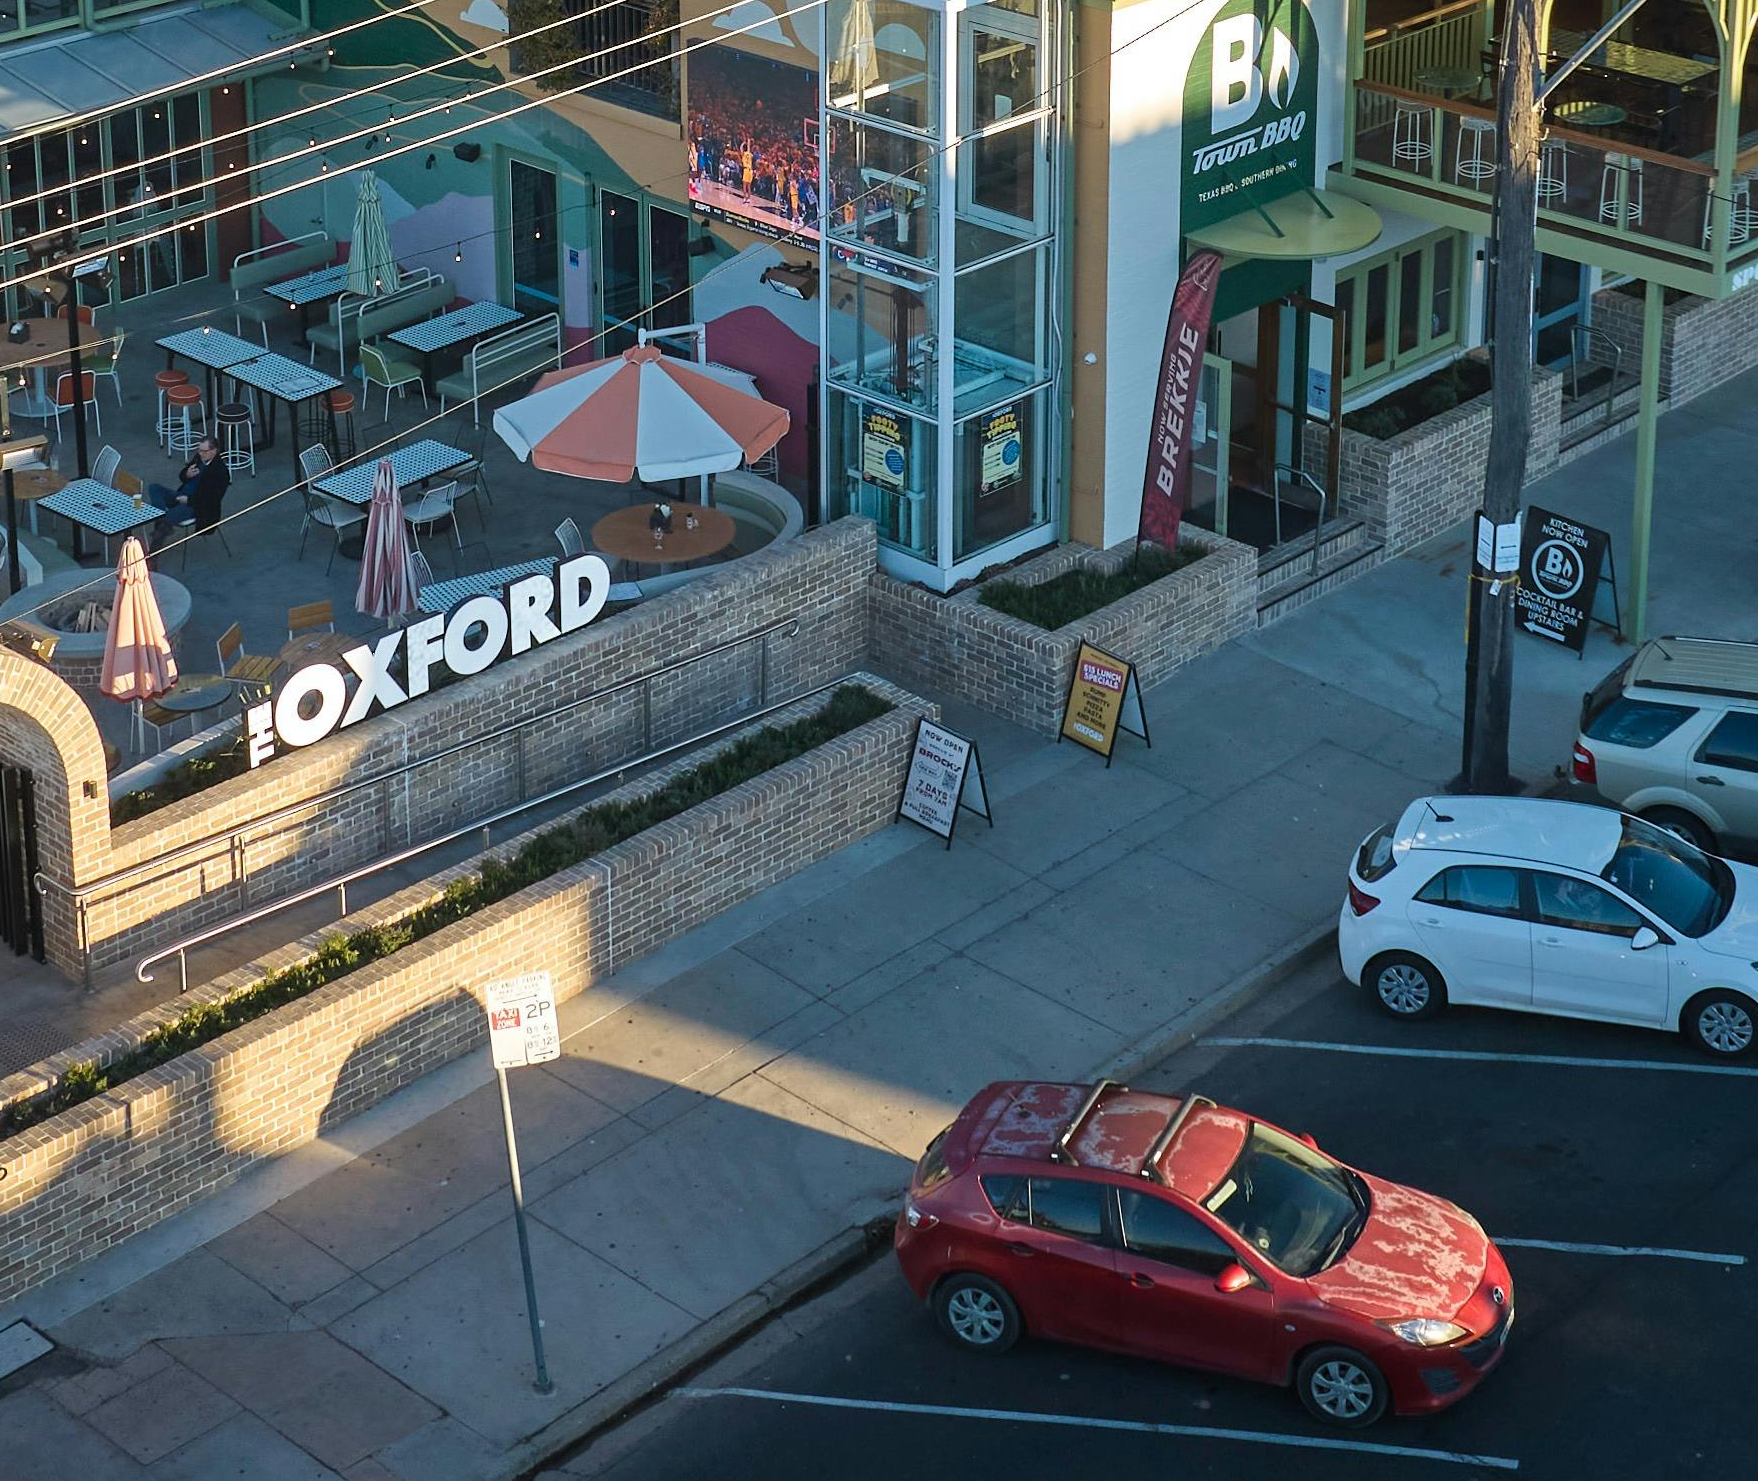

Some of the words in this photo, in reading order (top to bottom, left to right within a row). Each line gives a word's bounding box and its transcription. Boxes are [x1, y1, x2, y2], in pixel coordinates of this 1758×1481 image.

[1260, 110, 1307, 150] BBQ
[1199, 188, 1220, 203] TEXAS
[1241, 167, 1274, 187] SOUTHERN
[1157, 410, 1168, 444] NOW
[1163, 353, 1177, 411] SERVING
[1157, 321, 1199, 497] BREKKIE
[1542, 524, 1564, 539] NOW
[1565, 533, 1589, 548] OPEN
[1549, 518, 1584, 537] KITCHEN
[1516, 587, 1557, 609] COCKTAIL
[1560, 602, 1577, 615] BAR
[1518, 597, 1549, 616] DINING
[1550, 609, 1578, 627] ROOM
[1527, 610, 1565, 631] UPSTAIRS
[247, 700, 275, 769] THE
[275, 554, 611, 747] OXFORD
[1083, 672, 1119, 689] SPECIALS
[1096, 666, 1121, 682] LUNCH
[1084, 707, 1102, 720] PASTA
[924, 729, 942, 742] NOW
[944, 738, 963, 754] OPEN
[919, 747, 961, 772] BROCK'S
[916, 787, 933, 799] FROM
[918, 779, 923, 787] 7
[926, 782, 948, 800] DAYS
[496, 1008, 518, 1019] TAXI
[525, 1000, 551, 1019] 2P
